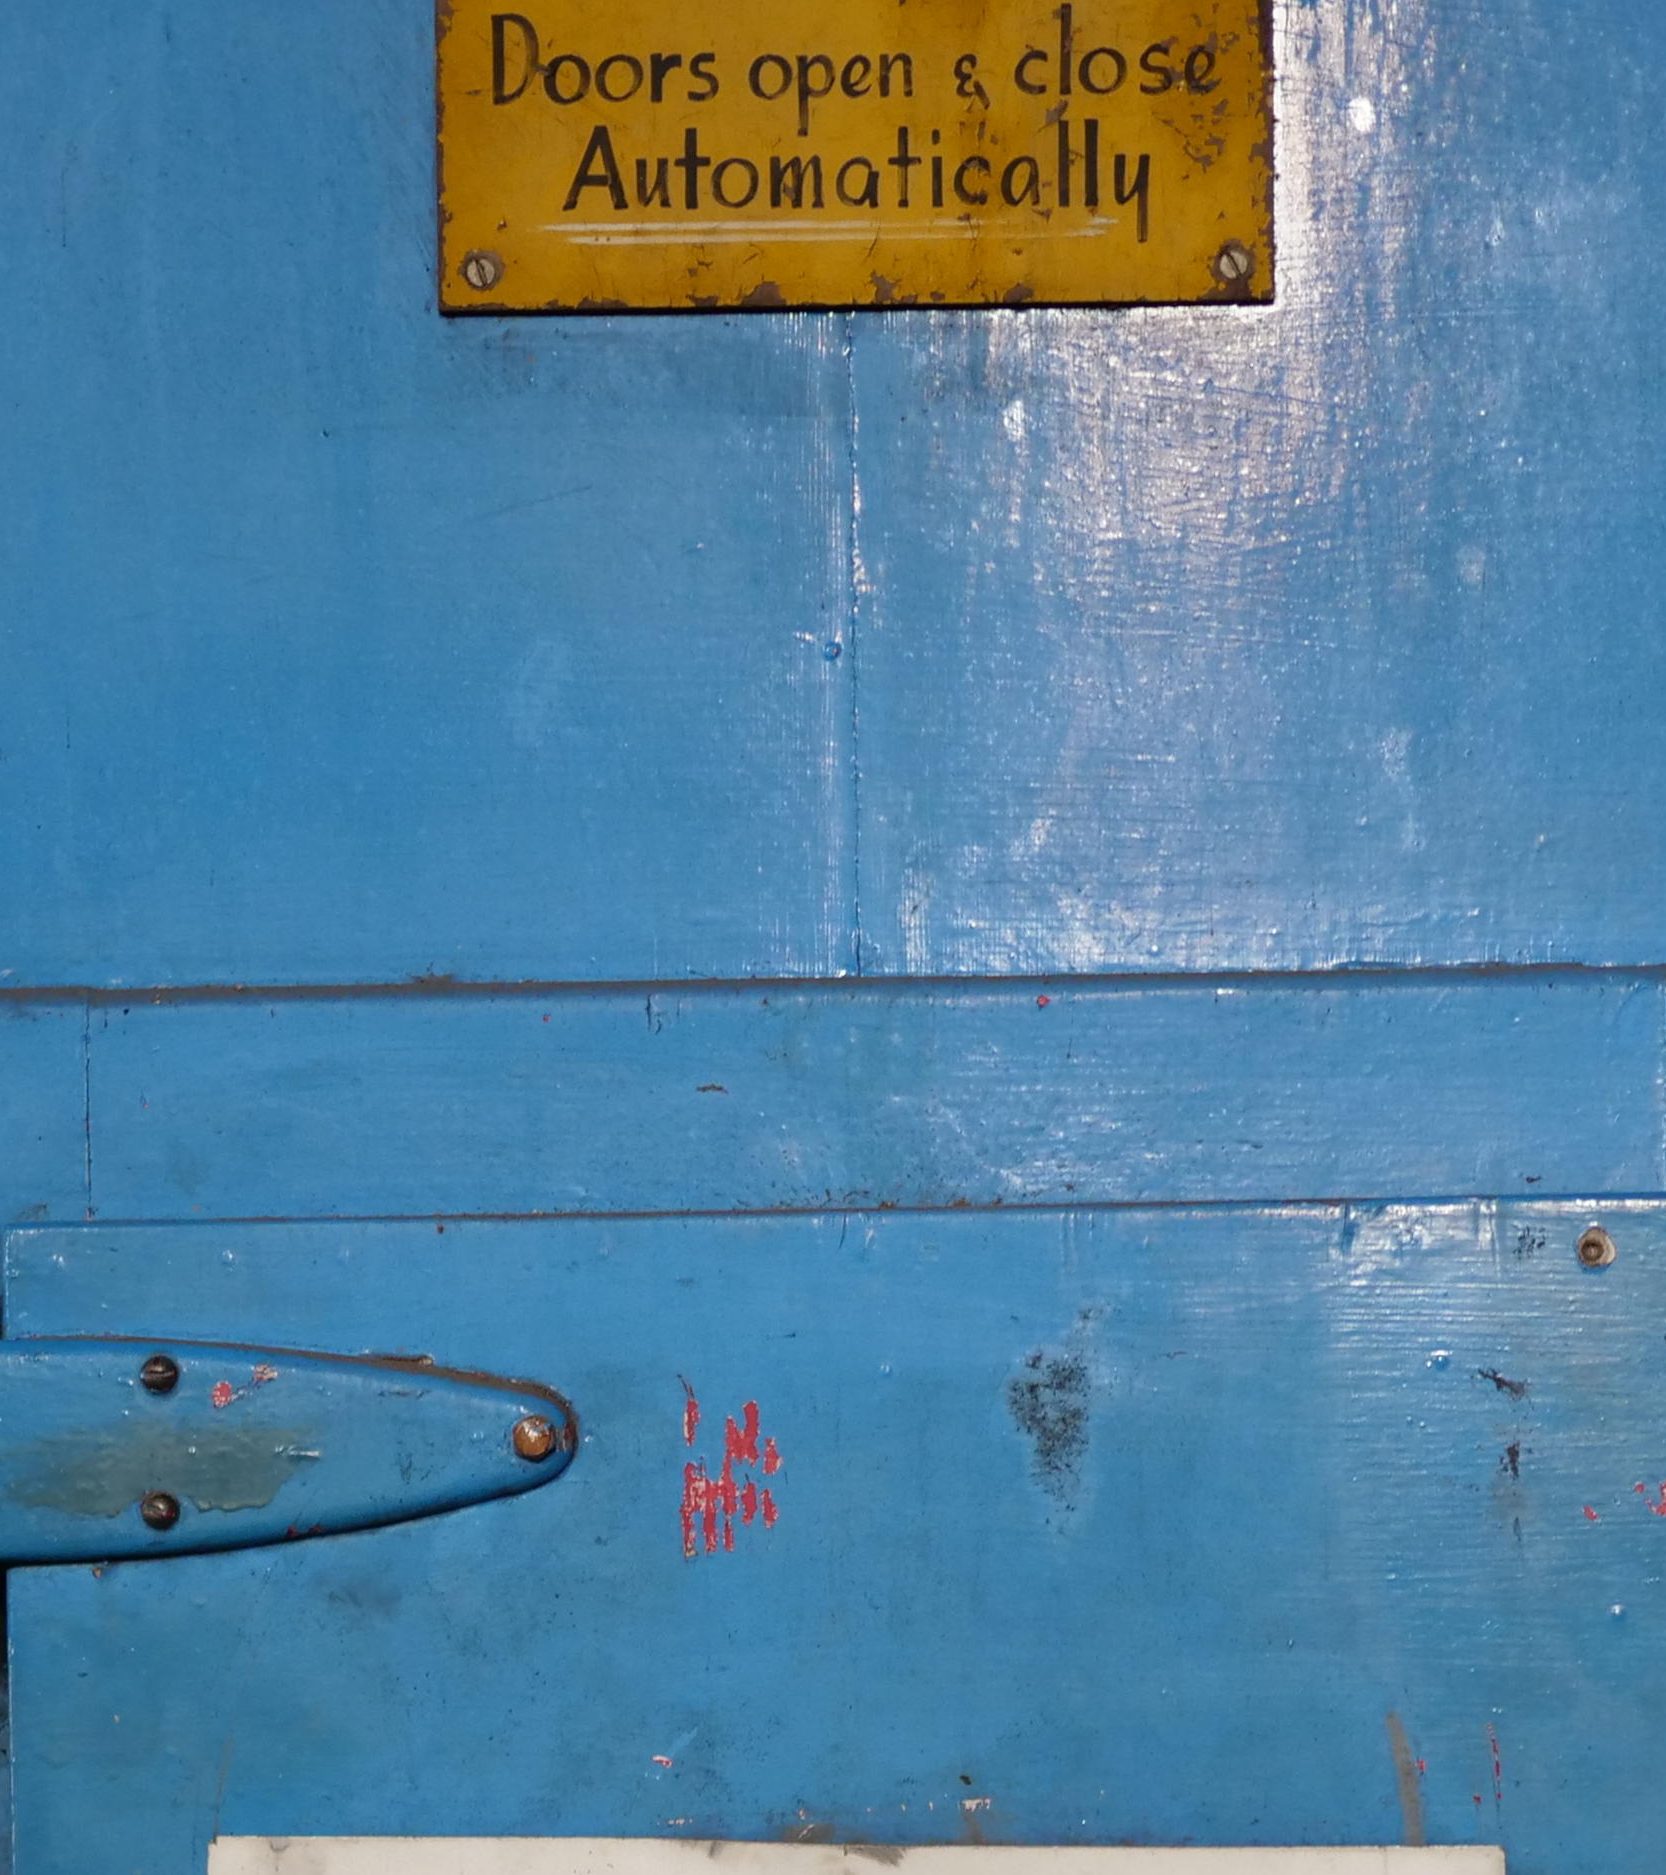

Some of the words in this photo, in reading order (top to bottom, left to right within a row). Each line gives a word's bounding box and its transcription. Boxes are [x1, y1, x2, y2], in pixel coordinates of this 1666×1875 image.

[491, 12, 721, 106] Doors
[748, 53, 914, 137] open
[953, 53, 991, 110] &
[1014, 3, 1221, 97] close
[562, 120, 1151, 243] Automatically
